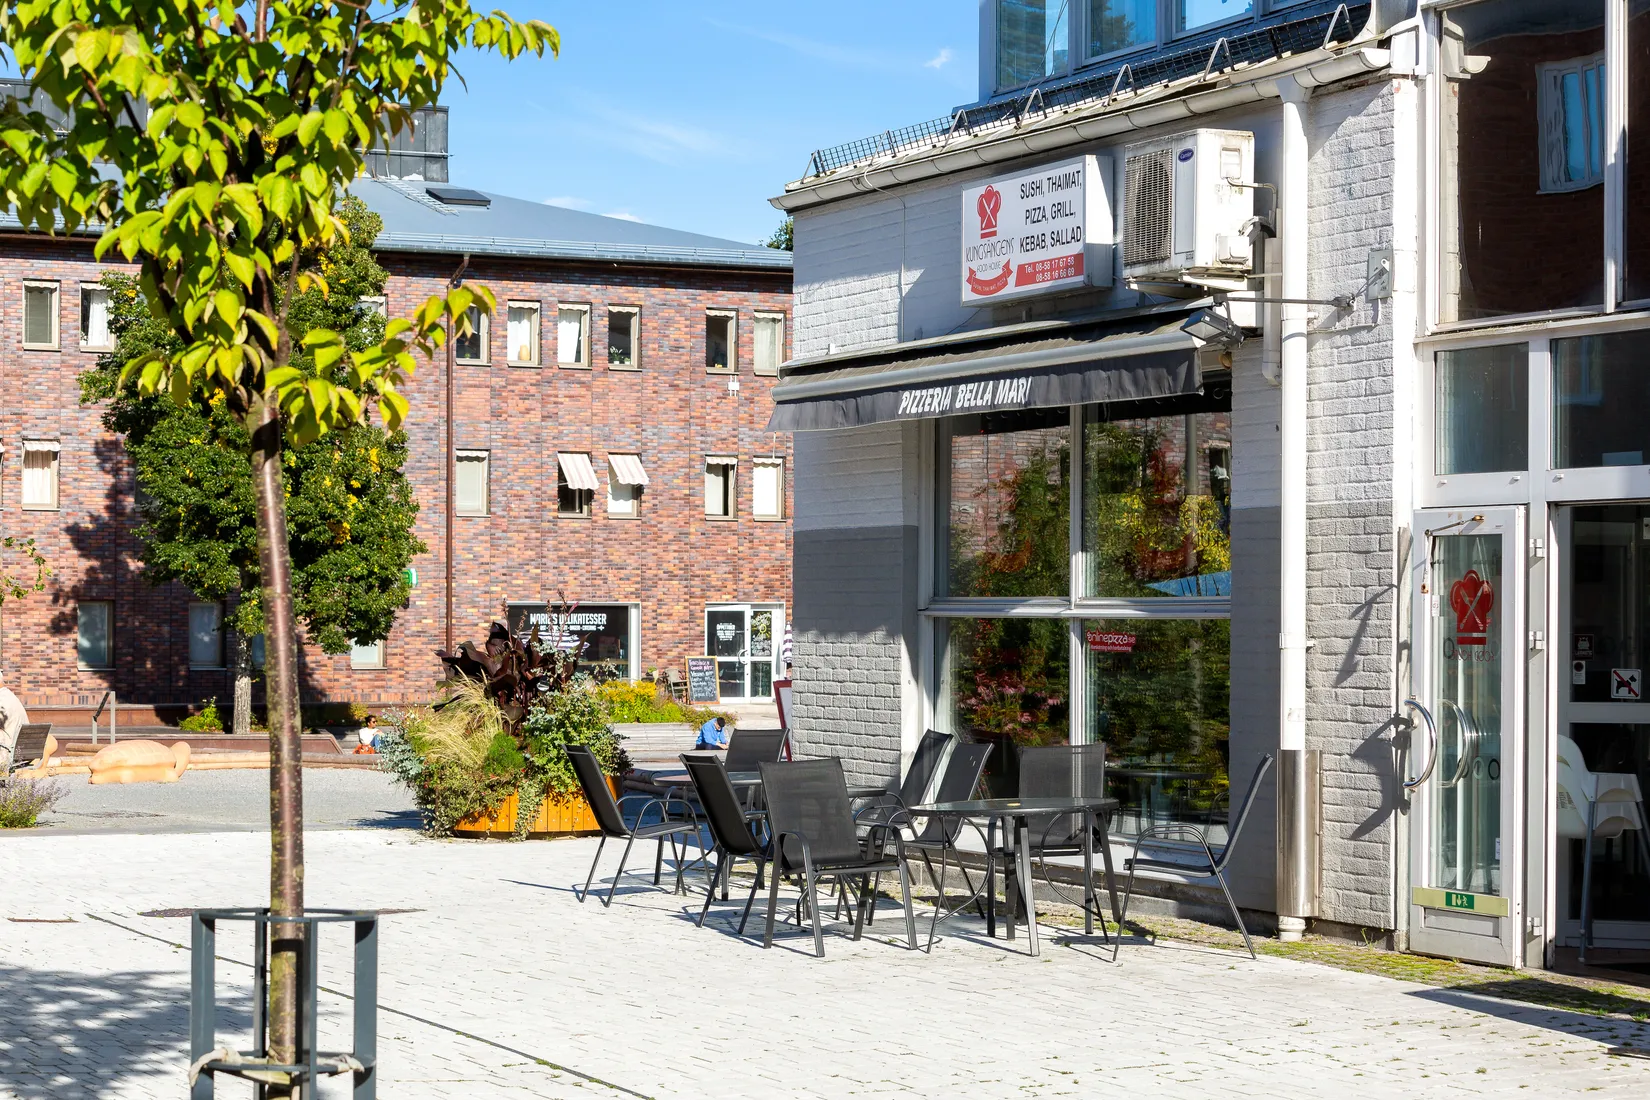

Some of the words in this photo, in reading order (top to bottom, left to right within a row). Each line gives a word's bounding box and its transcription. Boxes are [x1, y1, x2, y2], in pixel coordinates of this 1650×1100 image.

[1020, 179, 1044, 200] SUSHI,
[1046, 170, 1082, 194] THAIMAT,
[1025, 205, 1048, 225] PIZZA,
[1050, 200, 1076, 220] GRILL,
[966, 237, 1014, 262] KUNGSÄNGENS
[1020, 232, 1048, 254] KEBAB,
[1050, 226, 1082, 248] SALLAD
[989, 260, 1001, 270] HOUSE
[1024, 265, 1034, 274] Tel.
[1036, 261, 1050, 272] 08-58
[1052, 260, 1058, 268] 17
[1060, 258, 1066, 267] 67
[1068, 256, 1074, 266] 58
[1036, 272, 1050, 282] 08-58
[1052, 270, 1058, 279] 16
[1060, 269, 1066, 278] 66
[1068, 267, 1074, 276] 69
[898, 386, 952, 414] PIZZERIA
[955, 380, 994, 408] BELLA
[994, 376, 1032, 404] MARI
